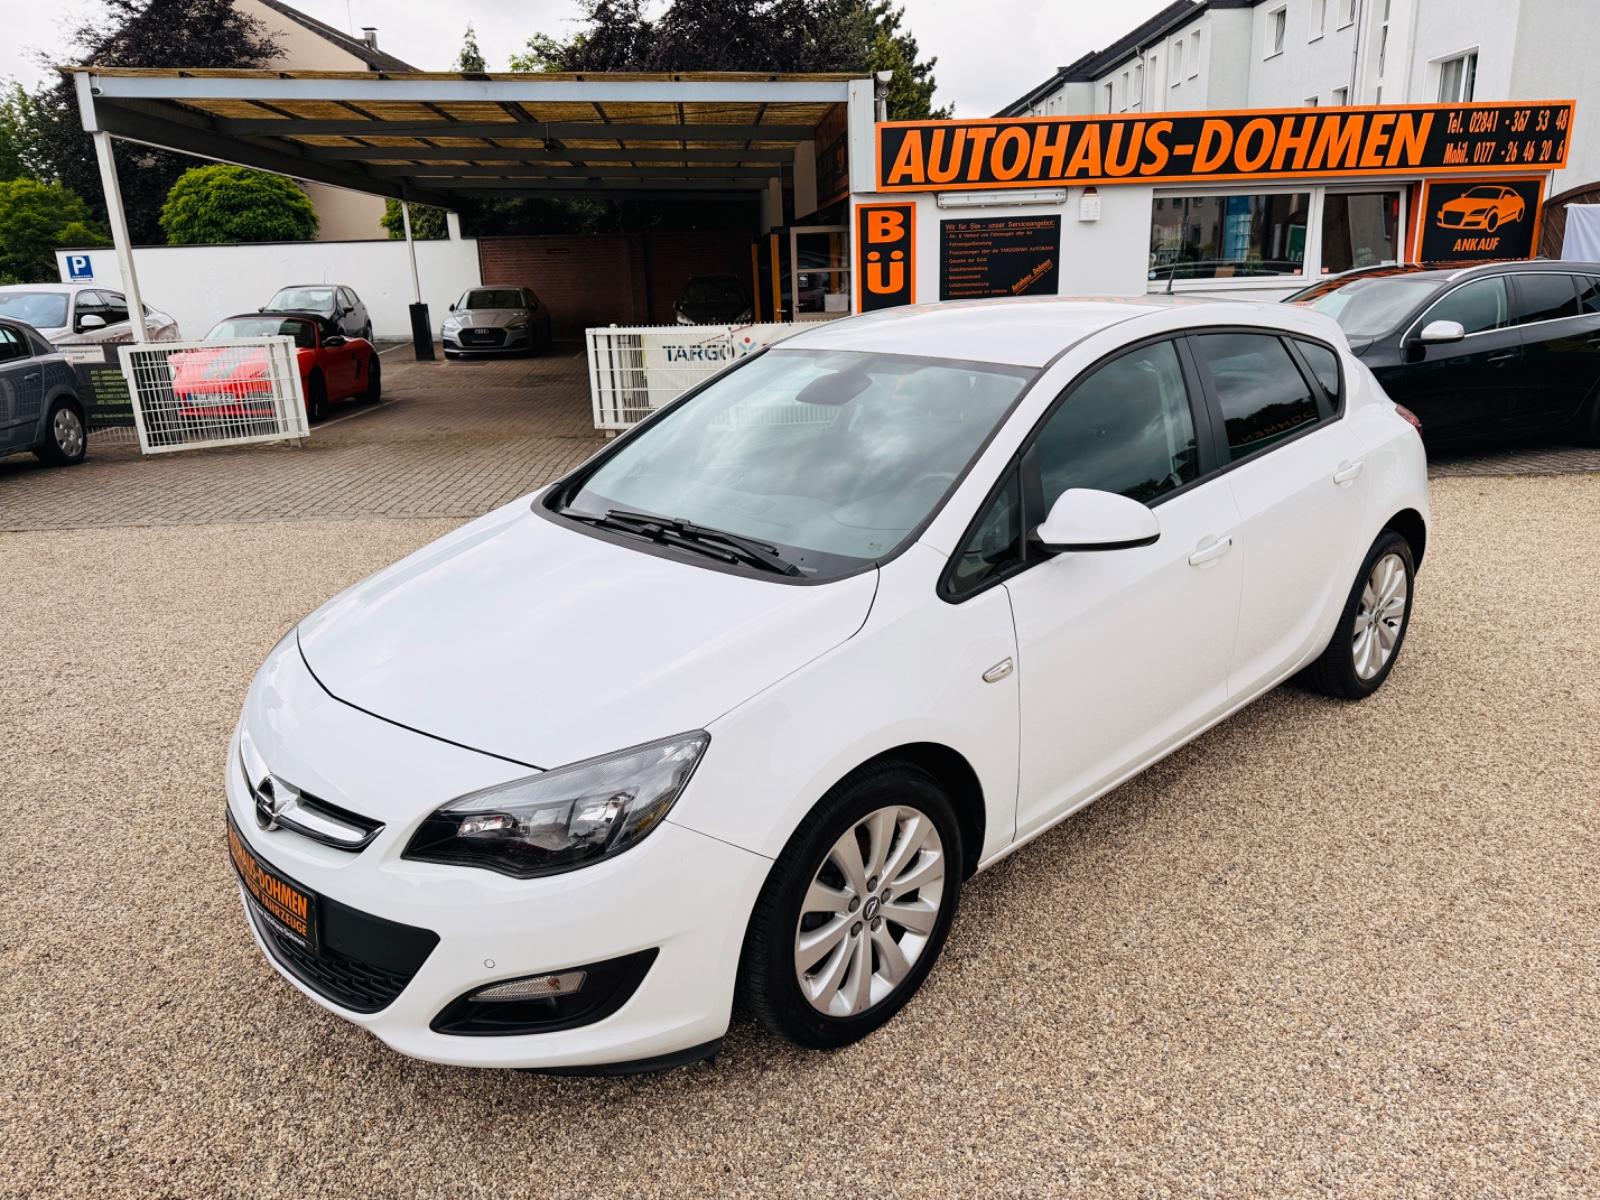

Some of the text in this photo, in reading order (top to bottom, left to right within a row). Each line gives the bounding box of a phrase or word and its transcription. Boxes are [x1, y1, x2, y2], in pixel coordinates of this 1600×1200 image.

[1447, 111, 1463, 133] Tel.
[1469, 111, 1499, 133] 02841
[1536, 110, 1550, 131] 53
[1556, 109, 1569, 130] 48
[887, 112, 1434, 184] AUTOHAUS-DOHMEN
[1443, 141, 1468, 164] Mobil.
[1474, 142, 1496, 163] 0177
[1524, 140, 1535, 162] 46
[1539, 140, 1552, 161] 20
[1453, 237, 1500, 252] ANKAUF
[72, 256, 86, 275] P
